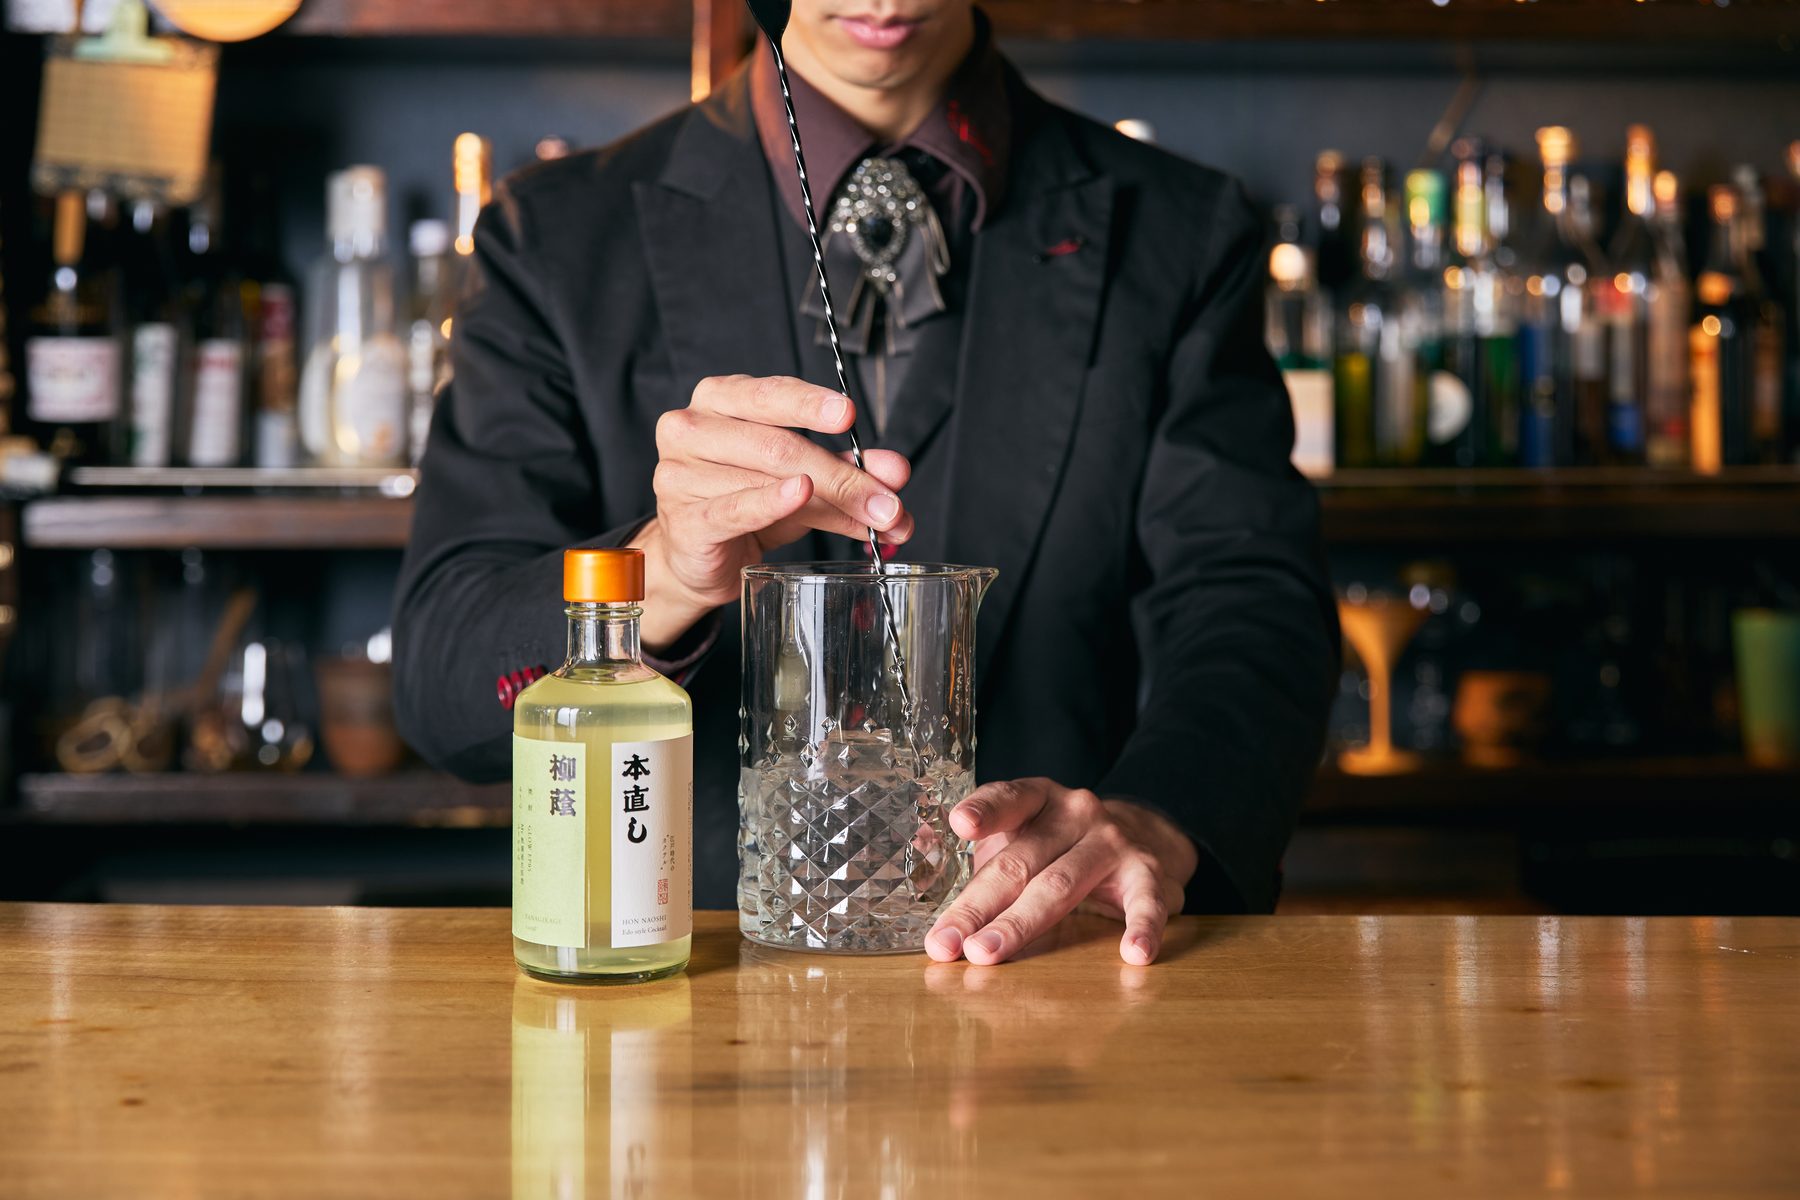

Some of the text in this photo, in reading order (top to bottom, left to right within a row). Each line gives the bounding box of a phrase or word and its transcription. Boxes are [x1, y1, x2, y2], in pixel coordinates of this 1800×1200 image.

[549, 754, 577, 817] 柳蔭
[621, 753, 651, 844] 本直し
[641, 914, 667, 924] NAOSHI
